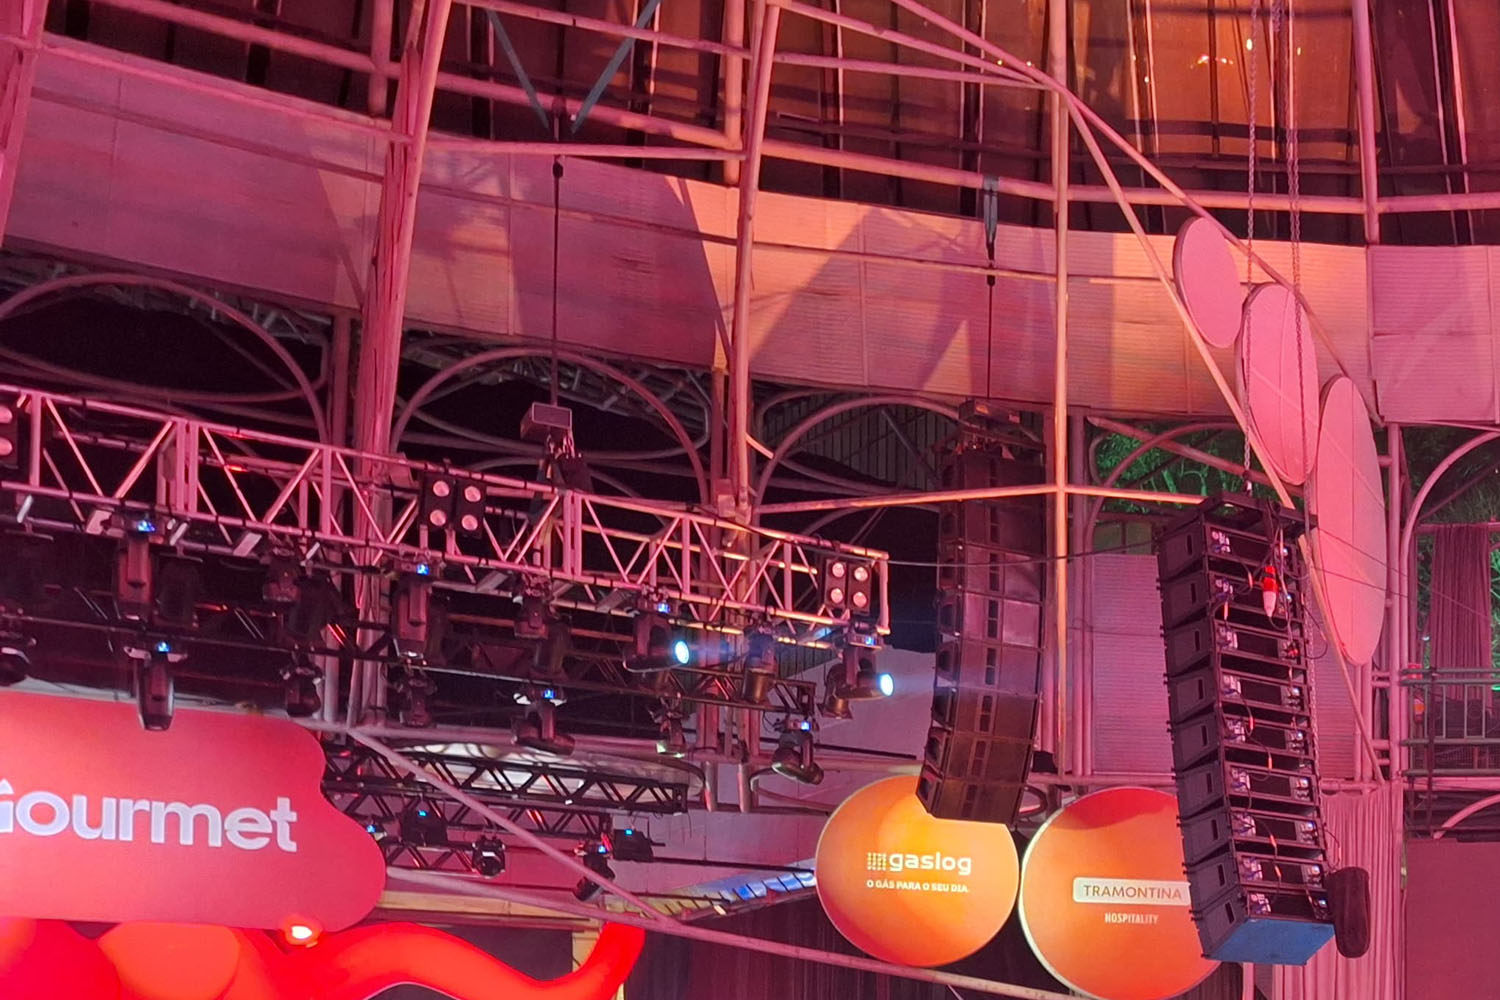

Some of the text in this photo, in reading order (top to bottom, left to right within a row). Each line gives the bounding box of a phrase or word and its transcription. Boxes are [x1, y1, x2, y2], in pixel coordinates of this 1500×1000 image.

[889, 852, 972, 876] gaslog
[866, 880, 875, 888] O
[896, 881, 921, 891] PARA
[922, 882, 931, 891] O
[932, 883, 949, 892] SEU
[1083, 885, 1182, 900] TRAMONTINA
[1105, 912, 1160, 925] HOSPITALITY
